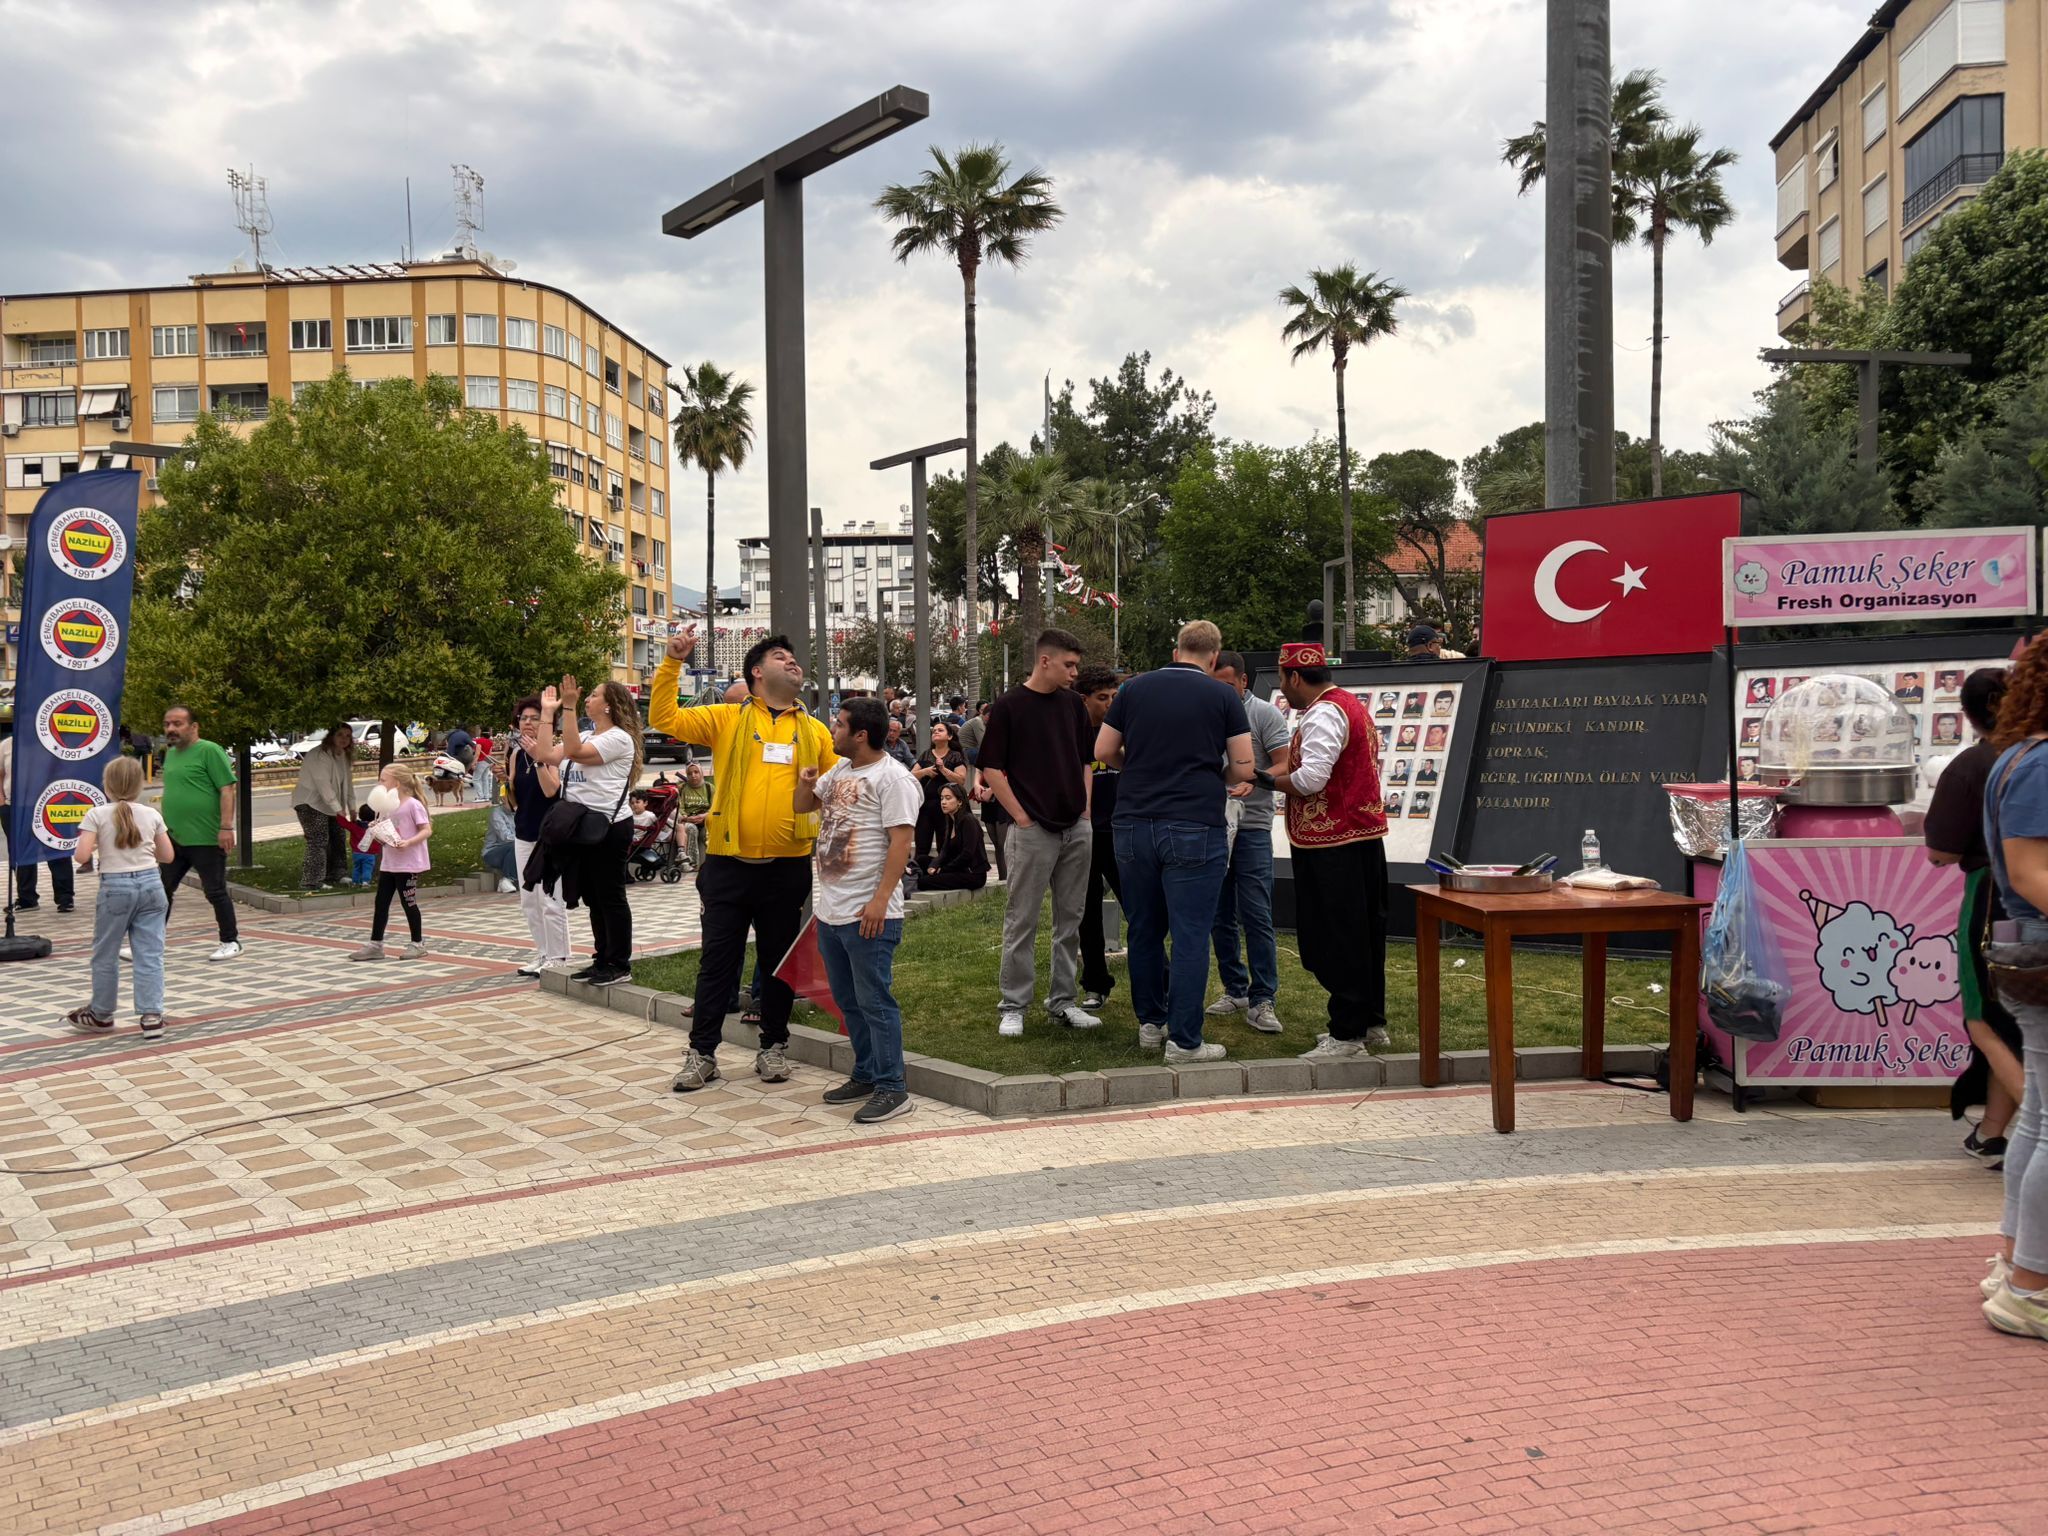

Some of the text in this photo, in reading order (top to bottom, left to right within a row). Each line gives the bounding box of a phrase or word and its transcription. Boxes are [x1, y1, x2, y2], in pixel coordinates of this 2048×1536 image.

[68, 536, 106, 549] NAZİLLİ
[73, 568, 95, 578] 1997
[1781, 551, 1976, 591] Pamuk Şeker
[1777, 592, 1977, 610] Fresh Organizasyon
[61, 627, 99, 639] NAZİLLİ
[67, 659, 88, 669] 1997
[1494, 692, 1709, 710] BAYRAKLARI BAYRAK YAPAN
[57, 718, 92, 728] NAZİLLİ
[60, 750, 82, 759] 1997
[1599, 770, 1642, 783] ÖLEN
[1650, 771, 1698, 783] VARSA
[50, 809, 88, 818] NAZİLL
[1788, 1033, 1896, 1069] Pamuk
